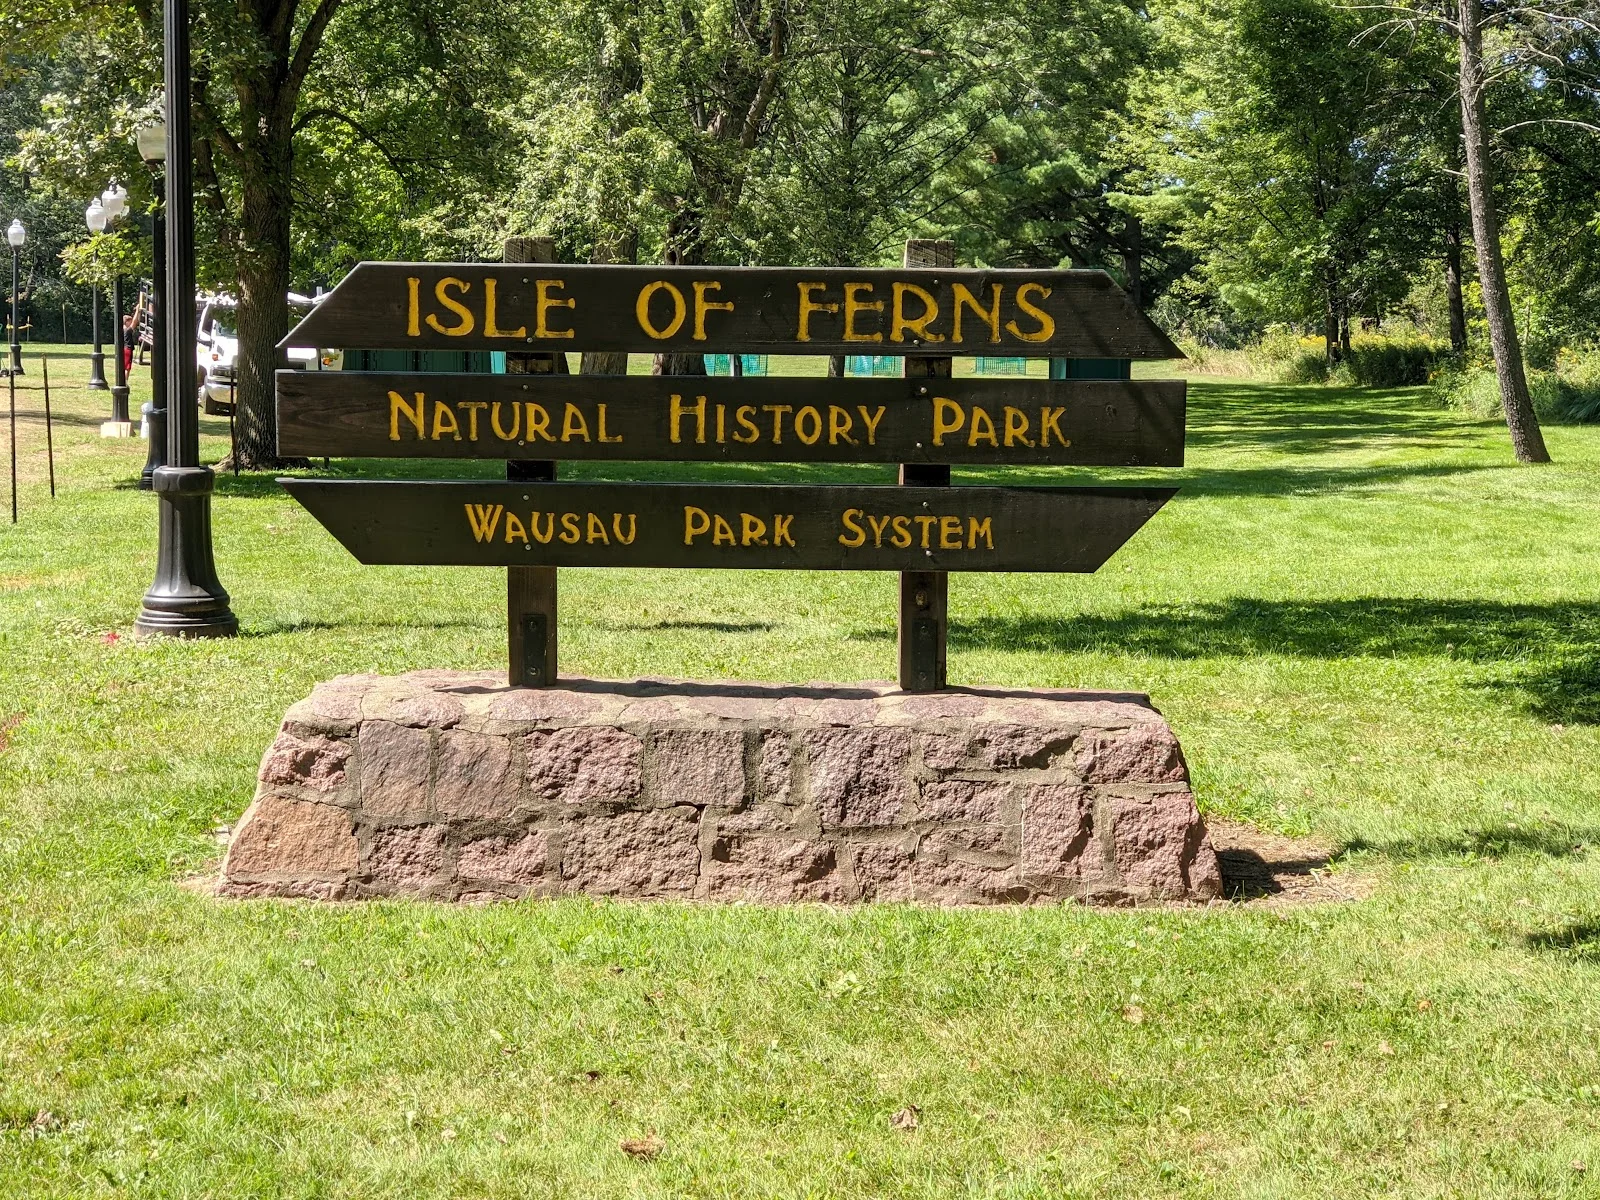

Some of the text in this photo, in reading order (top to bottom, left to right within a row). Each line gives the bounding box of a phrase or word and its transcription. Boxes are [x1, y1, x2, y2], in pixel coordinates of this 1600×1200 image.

[407, 276, 1056, 344] ISLE OF FERNS
[388, 391, 1072, 448] NATURAL HISTORY PARK
[465, 503, 994, 550] WAUSAU PARK SYSTEM
